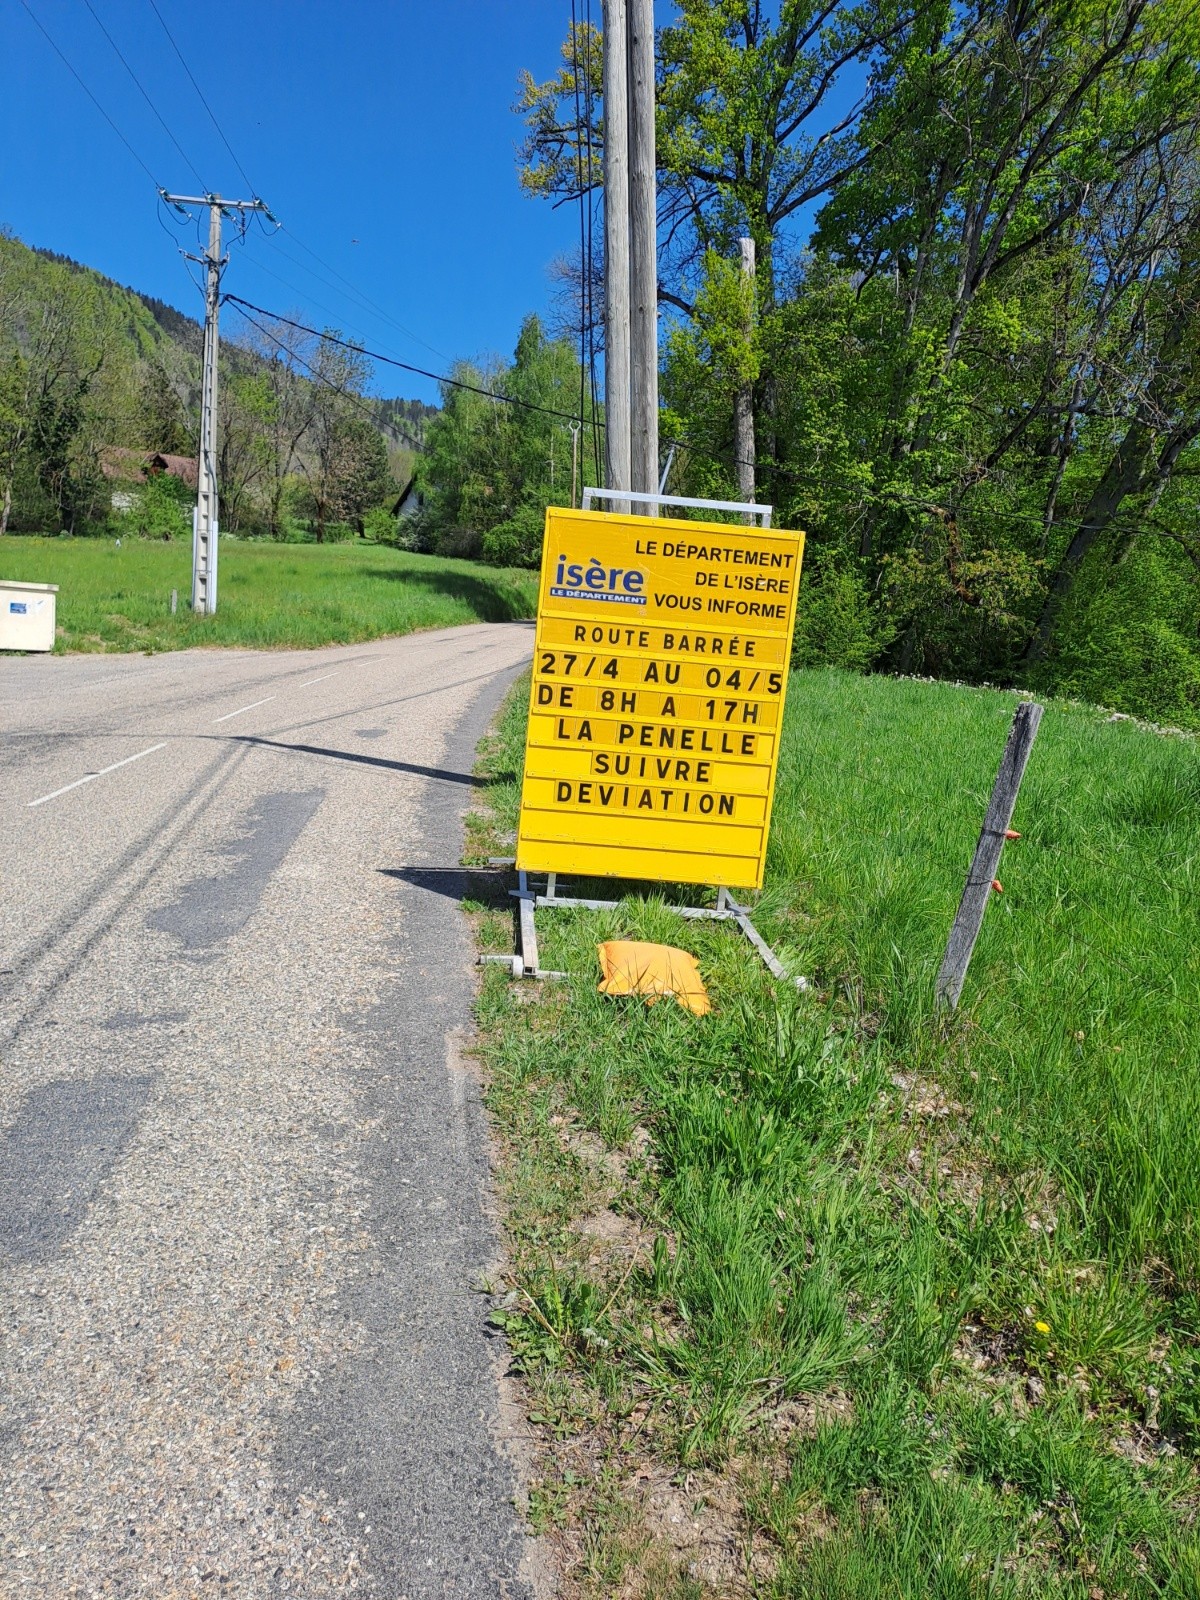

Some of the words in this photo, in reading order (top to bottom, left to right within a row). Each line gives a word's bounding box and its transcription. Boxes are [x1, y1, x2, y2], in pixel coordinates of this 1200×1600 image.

[636, 540, 657, 555] LE
[663, 541, 794, 567] DÉPARTEMENT
[556, 554, 644, 592] isère
[696, 572, 718, 586] DE
[566, 590, 646, 604] DÉPARTEMENT
[655, 594, 702, 611] VOUS
[708, 599, 786, 618] INFORME
[575, 626, 649, 647] ROUTE
[664, 634, 756, 657] BARRÉE
[540, 654, 618, 679] 27/4
[644, 662, 680, 684] AU
[706, 668, 782, 694] 04/5
[539, 685, 573, 707] DE
[600, 691, 636, 713] 8H
[662, 697, 675, 717] A
[707, 700, 758, 723] 17H
[558, 719, 592, 741] LA
[619, 724, 755, 755] PENELLE
[594, 754, 710, 782] SUIVRE
[557, 782, 734, 815] DEVIATION
